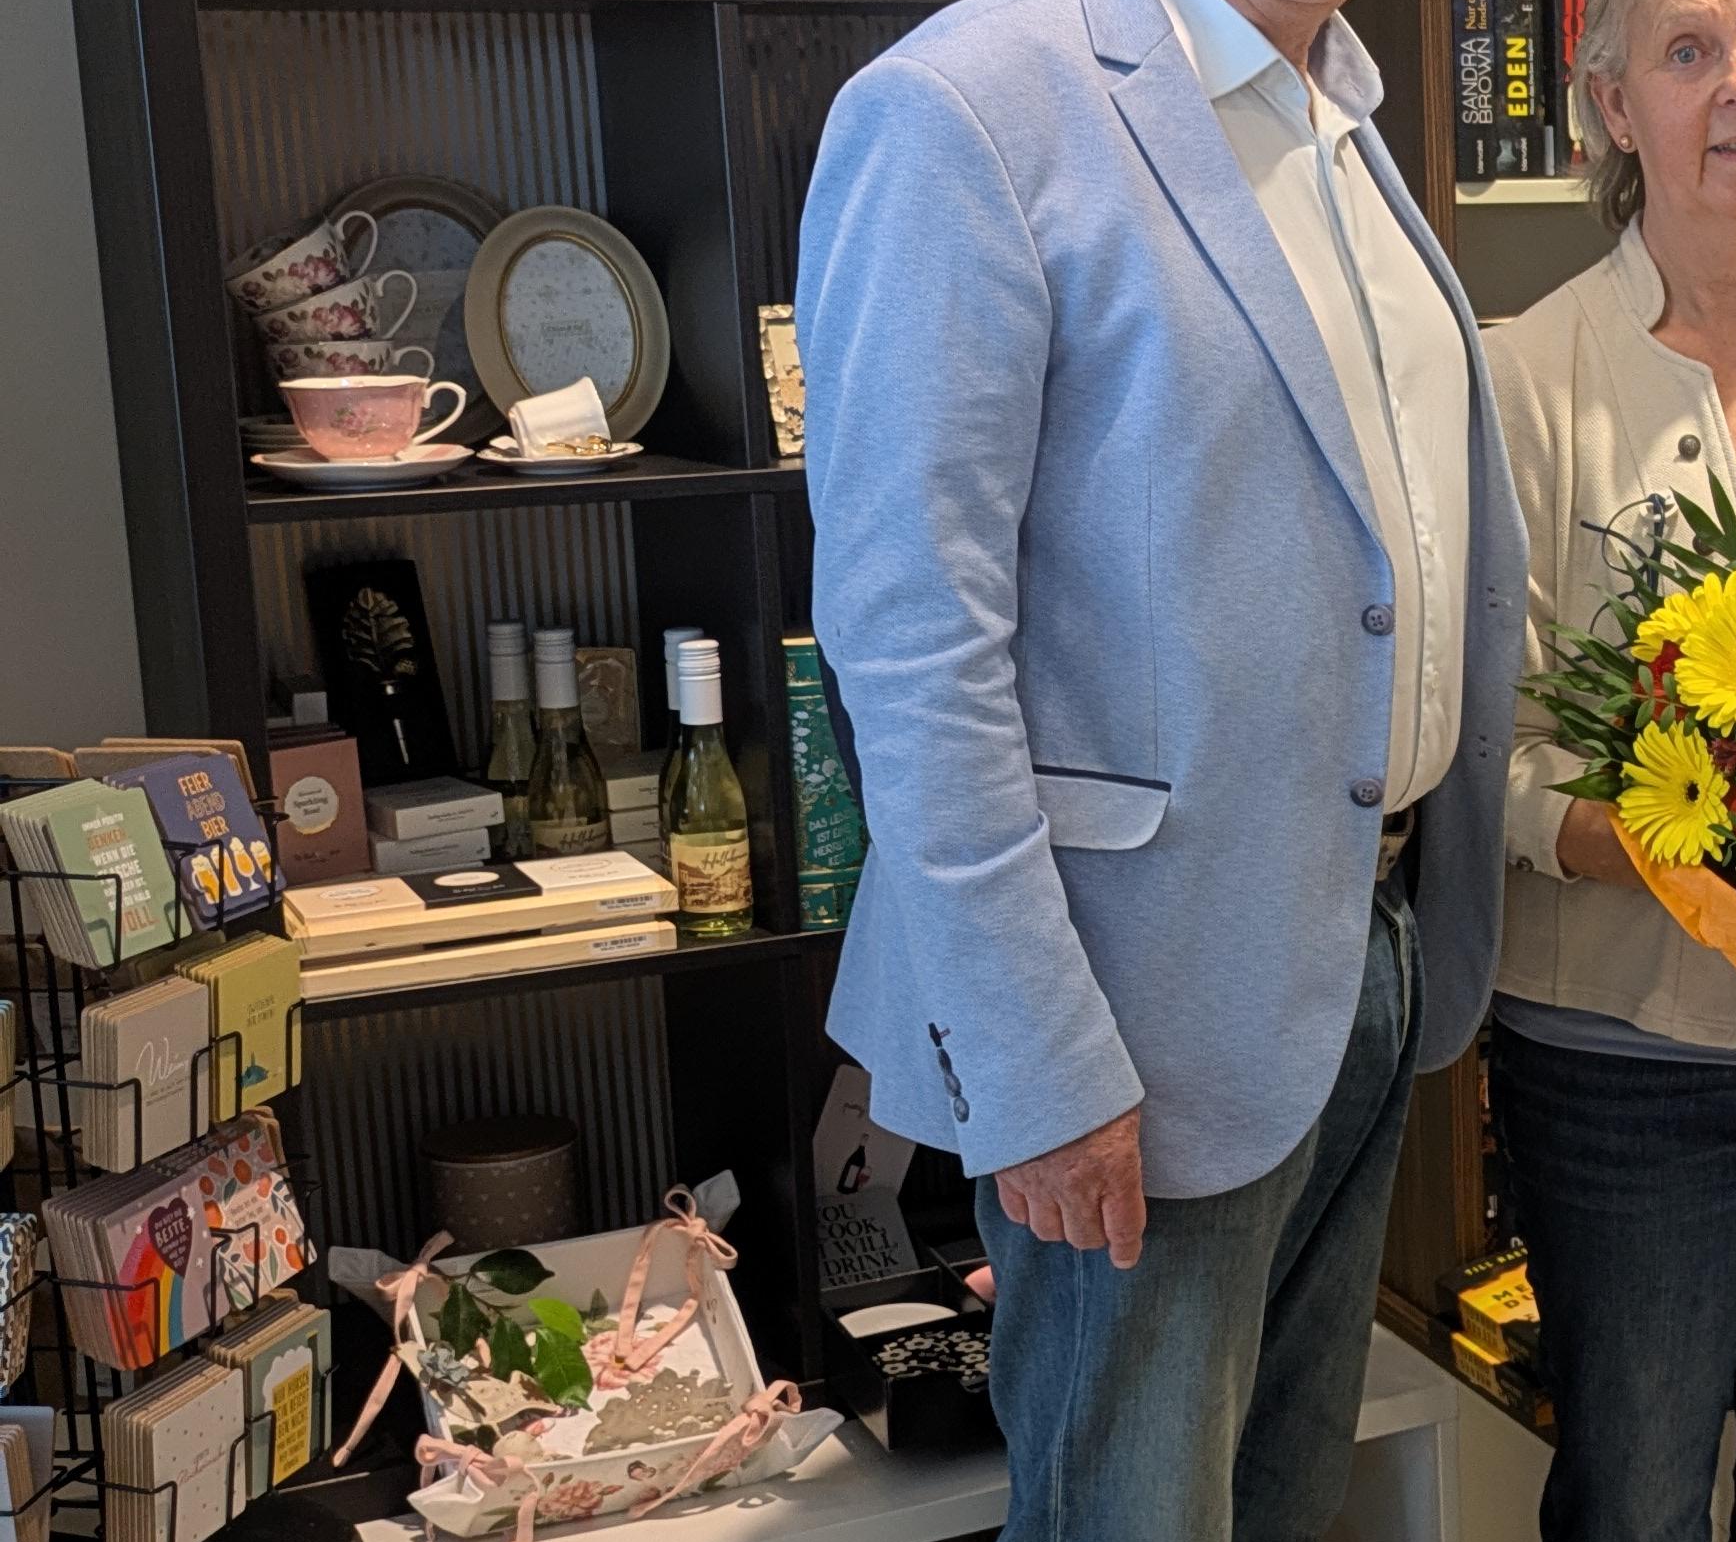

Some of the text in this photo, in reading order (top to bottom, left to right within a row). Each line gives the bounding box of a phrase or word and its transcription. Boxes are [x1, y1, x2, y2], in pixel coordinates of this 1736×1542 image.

[1465, 13, 1477, 30] Nur
[1461, 38, 1478, 124] SANDRA
[1477, 37, 1493, 124] BROWN
[1506, 37, 1529, 117] EDEN
[177, 771, 213, 797] FEIER
[201, 815, 230, 839] BIER
[808, 817, 828, 832] DAS
[823, 1250, 899, 1277] DRINK
